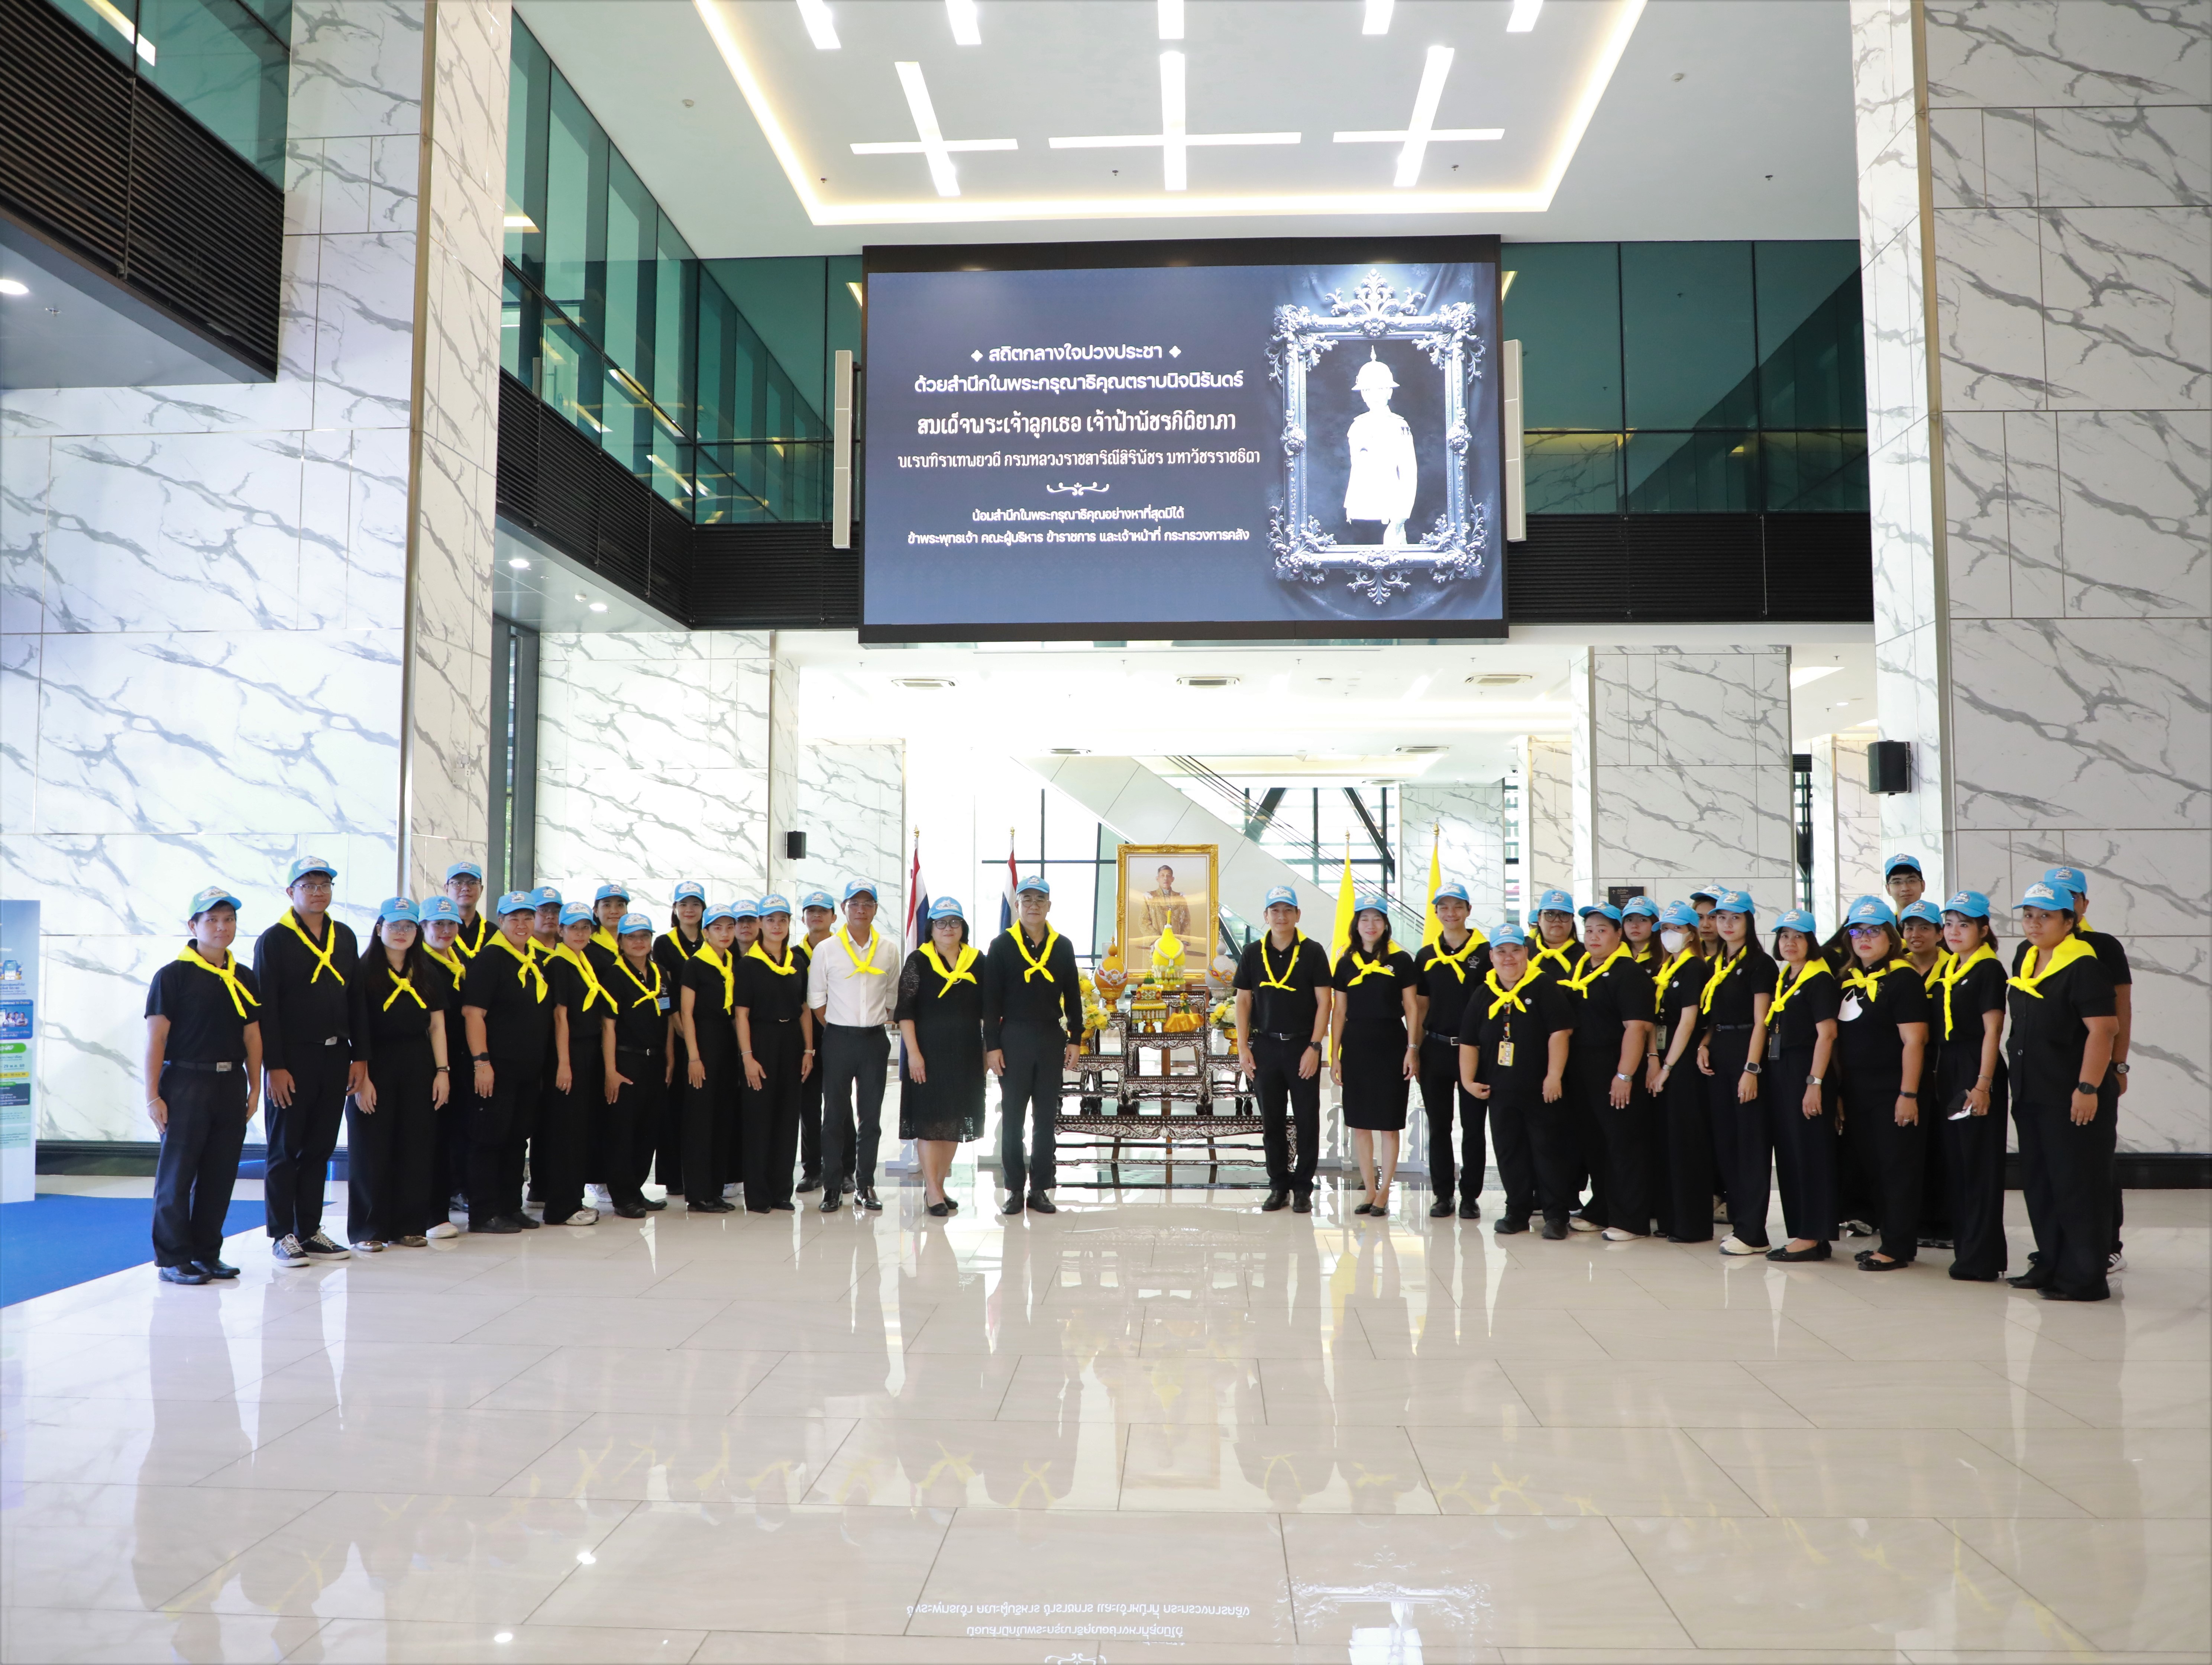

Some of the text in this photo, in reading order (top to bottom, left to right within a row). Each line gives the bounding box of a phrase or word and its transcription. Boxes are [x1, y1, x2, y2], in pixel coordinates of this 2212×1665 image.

[989, 343, 1162, 362] สถิตกลางใจปวงประชา
[915, 371, 1244, 395] ด้วยสำนึกในพระกรุณาธิคุณตราบนิจนิรันดร์
[918, 409, 1236, 439] สมเด็จพระเจ้าลูกเธอ เจ้าฟ้าพัชรกิติยาภา
[898, 448, 1260, 468] นเรนทิราเทพยวดี กรมหลวงราชสาริณีสิริพัชร มหาวัชรราชธิดา
[973, 504, 1185, 523] น้อมสำนึกในพระกรุณาธิคุณอย่างหาที่สุดมิได้
[908, 526, 1250, 547] ข้าพระพุทธเจ้า คณะผู้บริหาร ข้าราชการ และเจ้าหน้าที่ กระทรวงการคลัง
